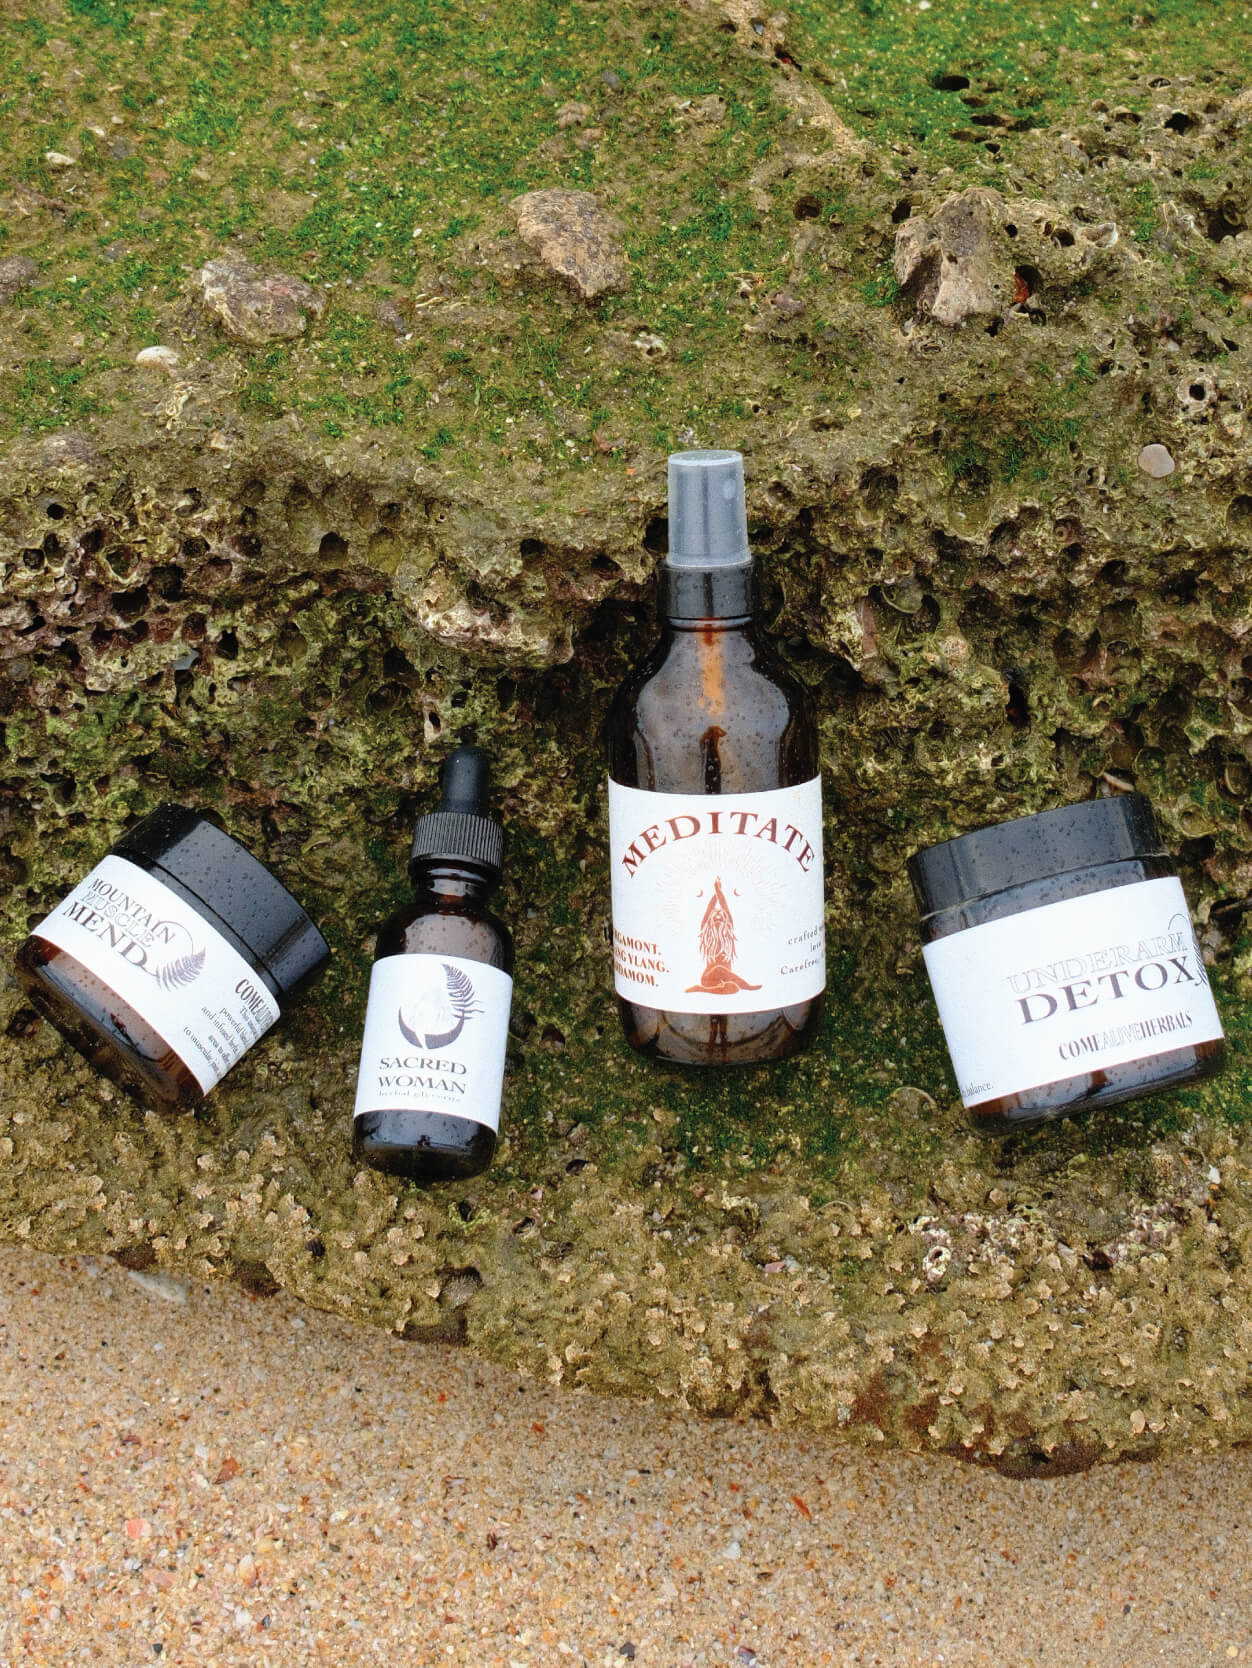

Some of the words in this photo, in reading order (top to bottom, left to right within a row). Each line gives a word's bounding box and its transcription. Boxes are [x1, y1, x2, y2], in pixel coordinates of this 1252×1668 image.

[622, 811, 815, 878] MEDITATE
[62, 901, 148, 967] MEND
[88, 877, 176, 944] MOUNTAIN
[1006, 932, 1188, 994] UNDERARM
[1016, 955, 1195, 1025] DETOX
[379, 1056, 467, 1075] SACRED
[1058, 1009, 1193, 1061] COMEALIVEHERBALS
[378, 1075, 466, 1095] WOMAN
